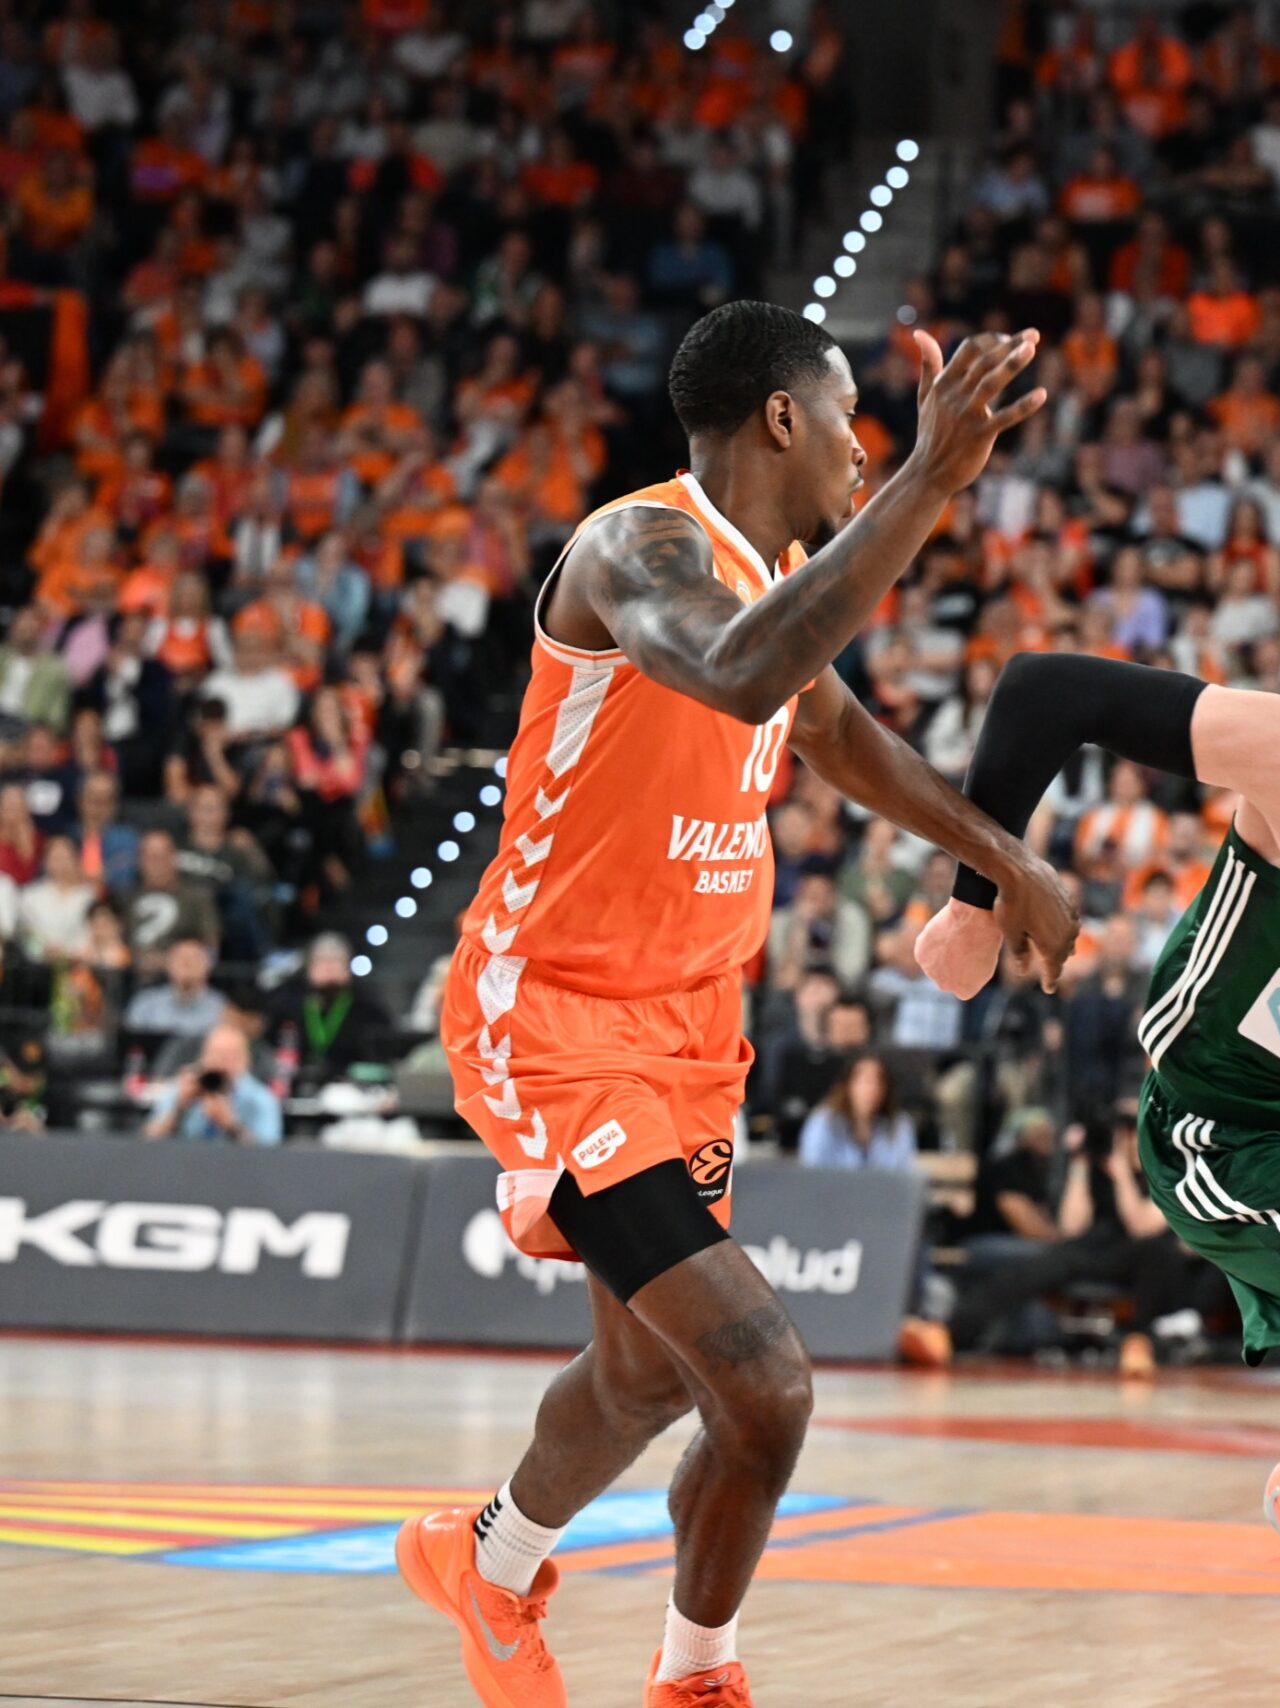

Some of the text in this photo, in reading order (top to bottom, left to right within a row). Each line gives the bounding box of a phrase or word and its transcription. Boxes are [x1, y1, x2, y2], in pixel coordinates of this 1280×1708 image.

[740, 705, 790, 792] 10
[693, 869, 754, 894] BASKET
[578, 1129, 619, 1161] PULEVA
[0, 1197, 350, 1279] KGM
